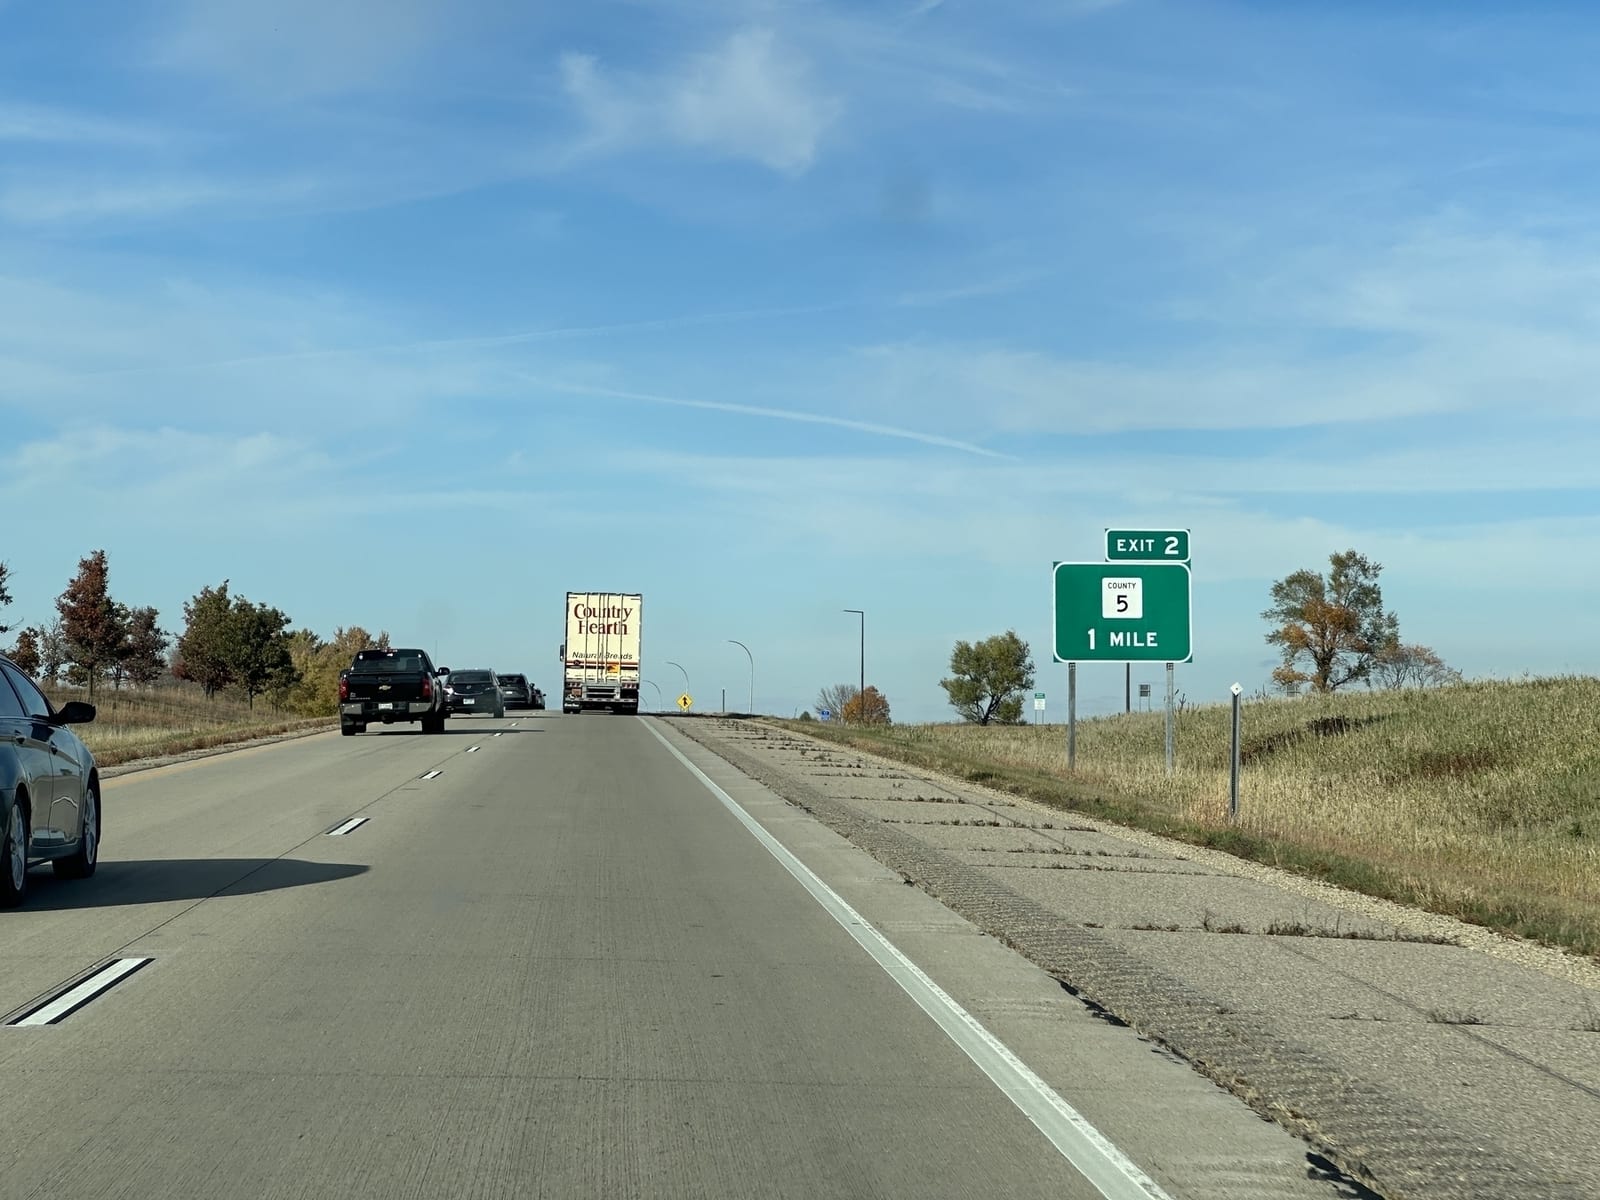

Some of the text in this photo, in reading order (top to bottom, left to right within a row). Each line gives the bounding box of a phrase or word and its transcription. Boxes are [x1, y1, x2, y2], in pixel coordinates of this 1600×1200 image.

[1116, 536, 1179, 555] EXIT 2
[574, 603, 633, 622] Country
[1116, 594, 1129, 613] 5
[578, 620, 628, 635] Hearth
[1087, 628, 1158, 650] 1 MILE
